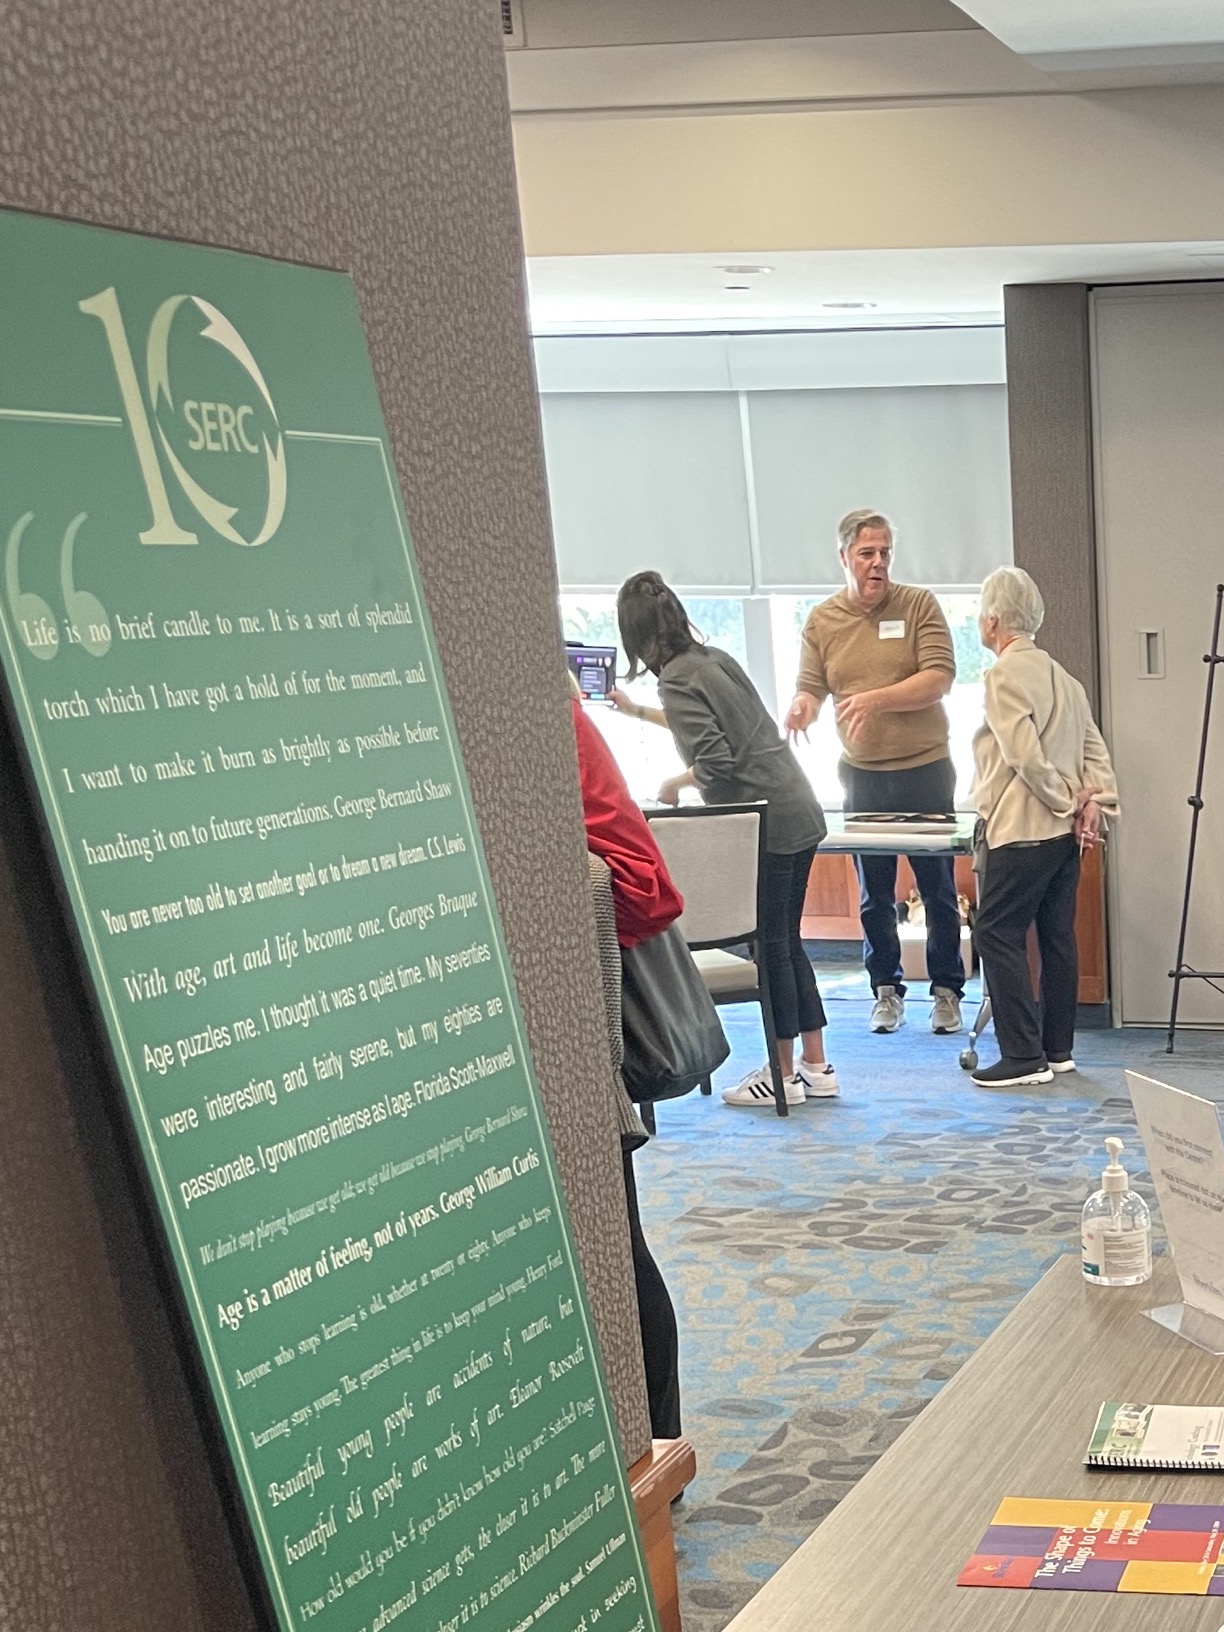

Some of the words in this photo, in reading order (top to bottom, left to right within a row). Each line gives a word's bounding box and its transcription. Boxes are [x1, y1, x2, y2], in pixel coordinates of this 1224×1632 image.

[183, 399, 259, 454] SERC
[20, 617, 58, 646] Life
[63, 618, 82, 644] is
[88, 623, 111, 642] no
[115, 611, 157, 640] brief
[162, 610, 211, 637] candle
[215, 613, 233, 634] to
[237, 616, 265, 633] me.
[267, 608, 283, 632] It
[284, 608, 299, 631] is
[303, 613, 314, 630] a
[317, 609, 343, 629] sort
[347, 603, 361, 627] of
[364, 601, 413, 633] splendid
[122, 966, 168, 1003] With
[174, 965, 207, 997] age,
[212, 952, 237, 979] art
[242, 937, 272, 971] and
[274, 931, 299, 968] life
[302, 925, 353, 954] become
[357, 917, 385, 939] one.
[387, 902, 435, 930] Georges
[437, 891, 478, 918] Braque
[143, 1043, 175, 1075] Age
[175, 1023, 232, 1068] puzzles
[232, 1017, 261, 1042] me.
[269, 993, 320, 1029] thought
[317, 989, 331, 1013] it
[330, 986, 357, 1010] was
[368, 969, 398, 1003] quiet
[396, 964, 426, 988] time.
[424, 954, 443, 982] My
[444, 941, 491, 973] seventies
[217, 1300, 244, 1331] Age
[243, 1288, 259, 1313] is
[271, 1265, 313, 1300] matter
[314, 1249, 330, 1278] of
[329, 1236, 373, 1270] feeling,
[373, 1221, 394, 1248] not
[394, 1210, 408, 1237] of
[407, 1204, 440, 1237] years.
[439, 1184, 476, 1213] George
[474, 1165, 513, 1195] William
[511, 1147, 540, 1176] Curtis
[1057, 1523, 1078, 1534] of
[1081, 1508, 1109, 1534] Come:
[1043, 1534, 1075, 1561] Shape
[1077, 1534, 1097, 1545] to
[1033, 1560, 1060, 1578] The
[1060, 1546, 1096, 1574] Things
[589, 1608, 601, 1623] in
[604, 1575, 637, 1611] seeking
